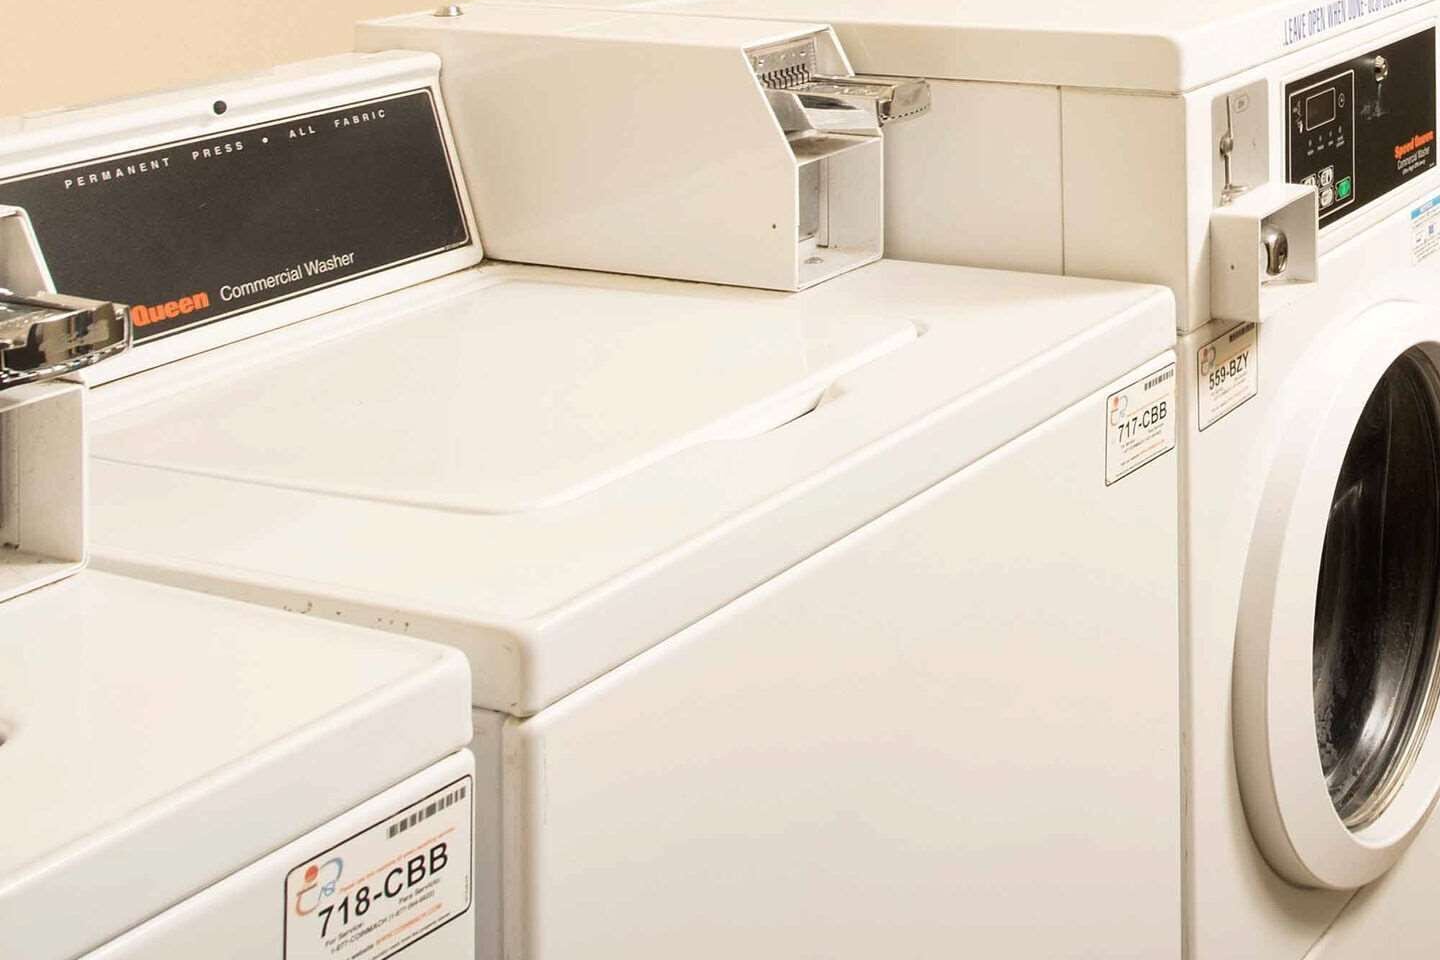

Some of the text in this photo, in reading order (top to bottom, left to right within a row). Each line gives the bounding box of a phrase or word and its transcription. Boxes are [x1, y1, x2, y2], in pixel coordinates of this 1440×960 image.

[1283, 12, 1306, 45] LEAVE
[1308, 6, 1326, 35] OPEN
[63, 109, 387, 189] PERMANENT PRESS ALL FABRIC
[130, 251, 355, 327] Queen Commercial Washer
[1208, 351, 1249, 391] 559-BZY
[1117, 400, 1168, 443] 717-CBB
[317, 841, 449, 939] 718-CBB
